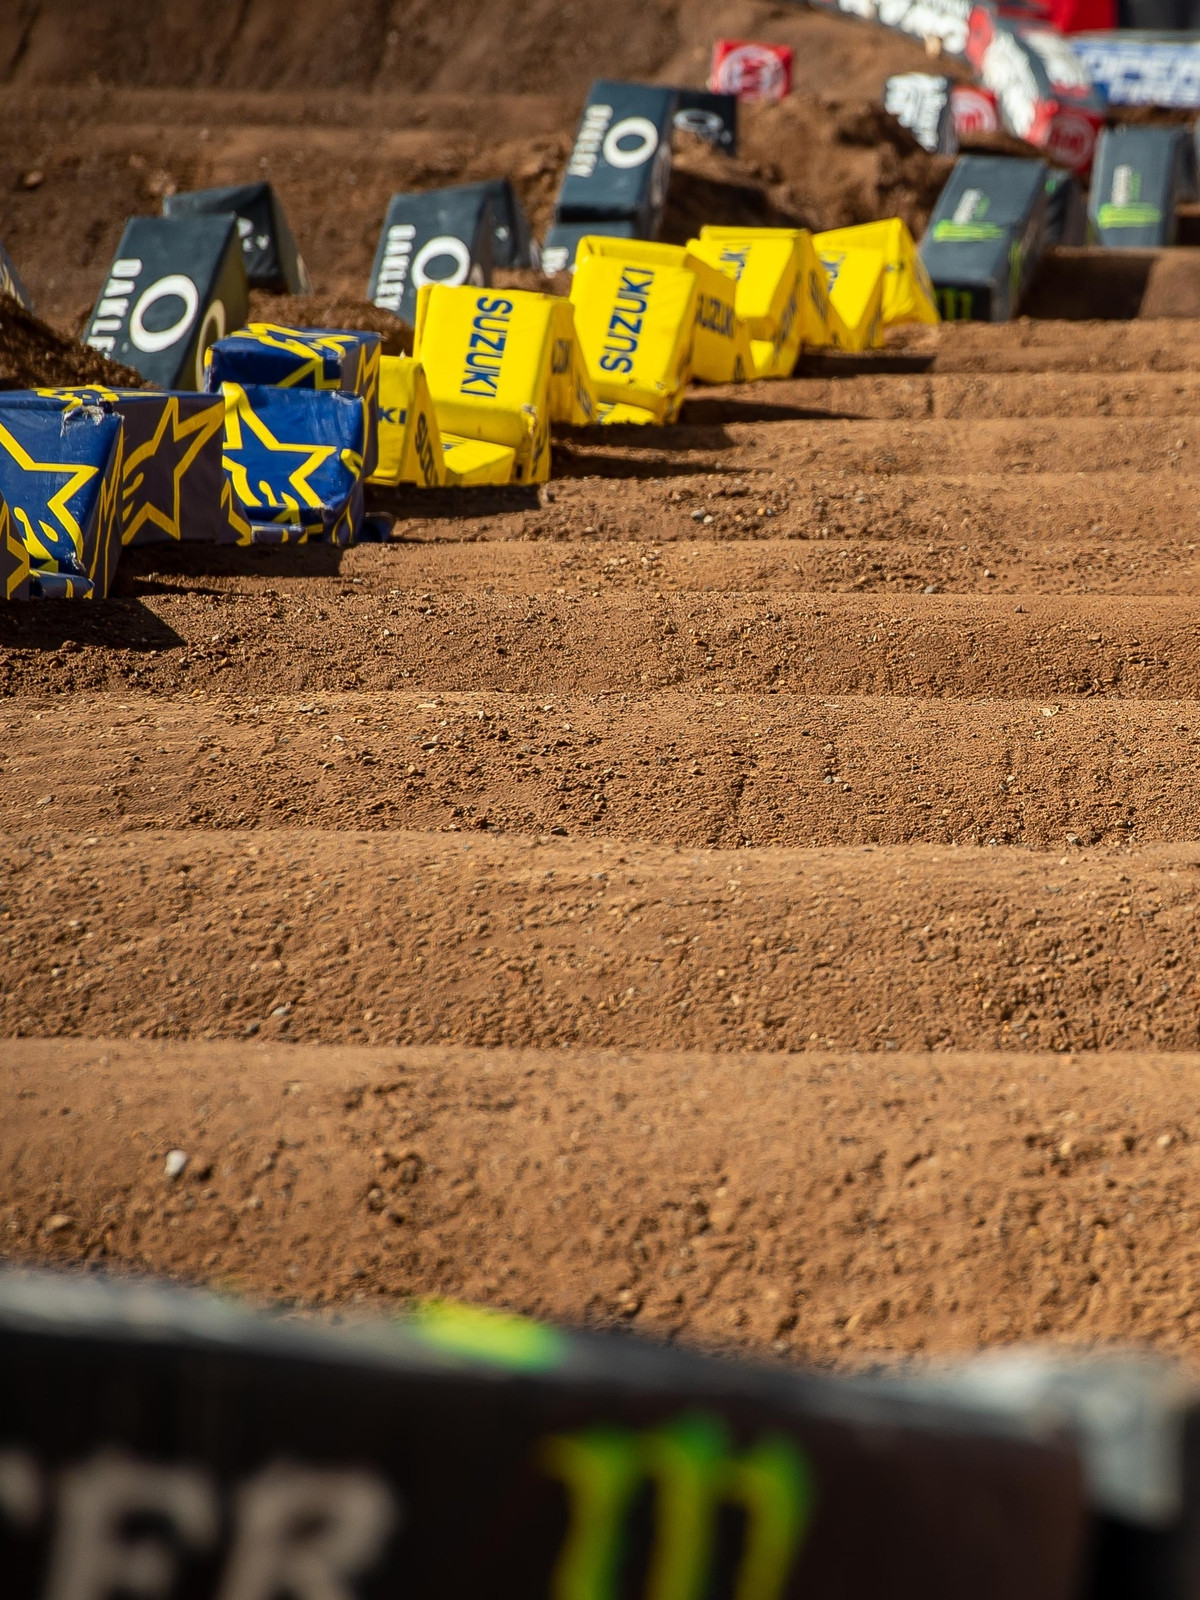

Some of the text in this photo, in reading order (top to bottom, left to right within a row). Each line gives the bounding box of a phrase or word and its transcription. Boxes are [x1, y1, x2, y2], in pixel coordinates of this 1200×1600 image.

[86, 258, 143, 361] OAKLE
[460, 296, 514, 398] SUZUKI
[600, 265, 656, 375] SUZUKI
